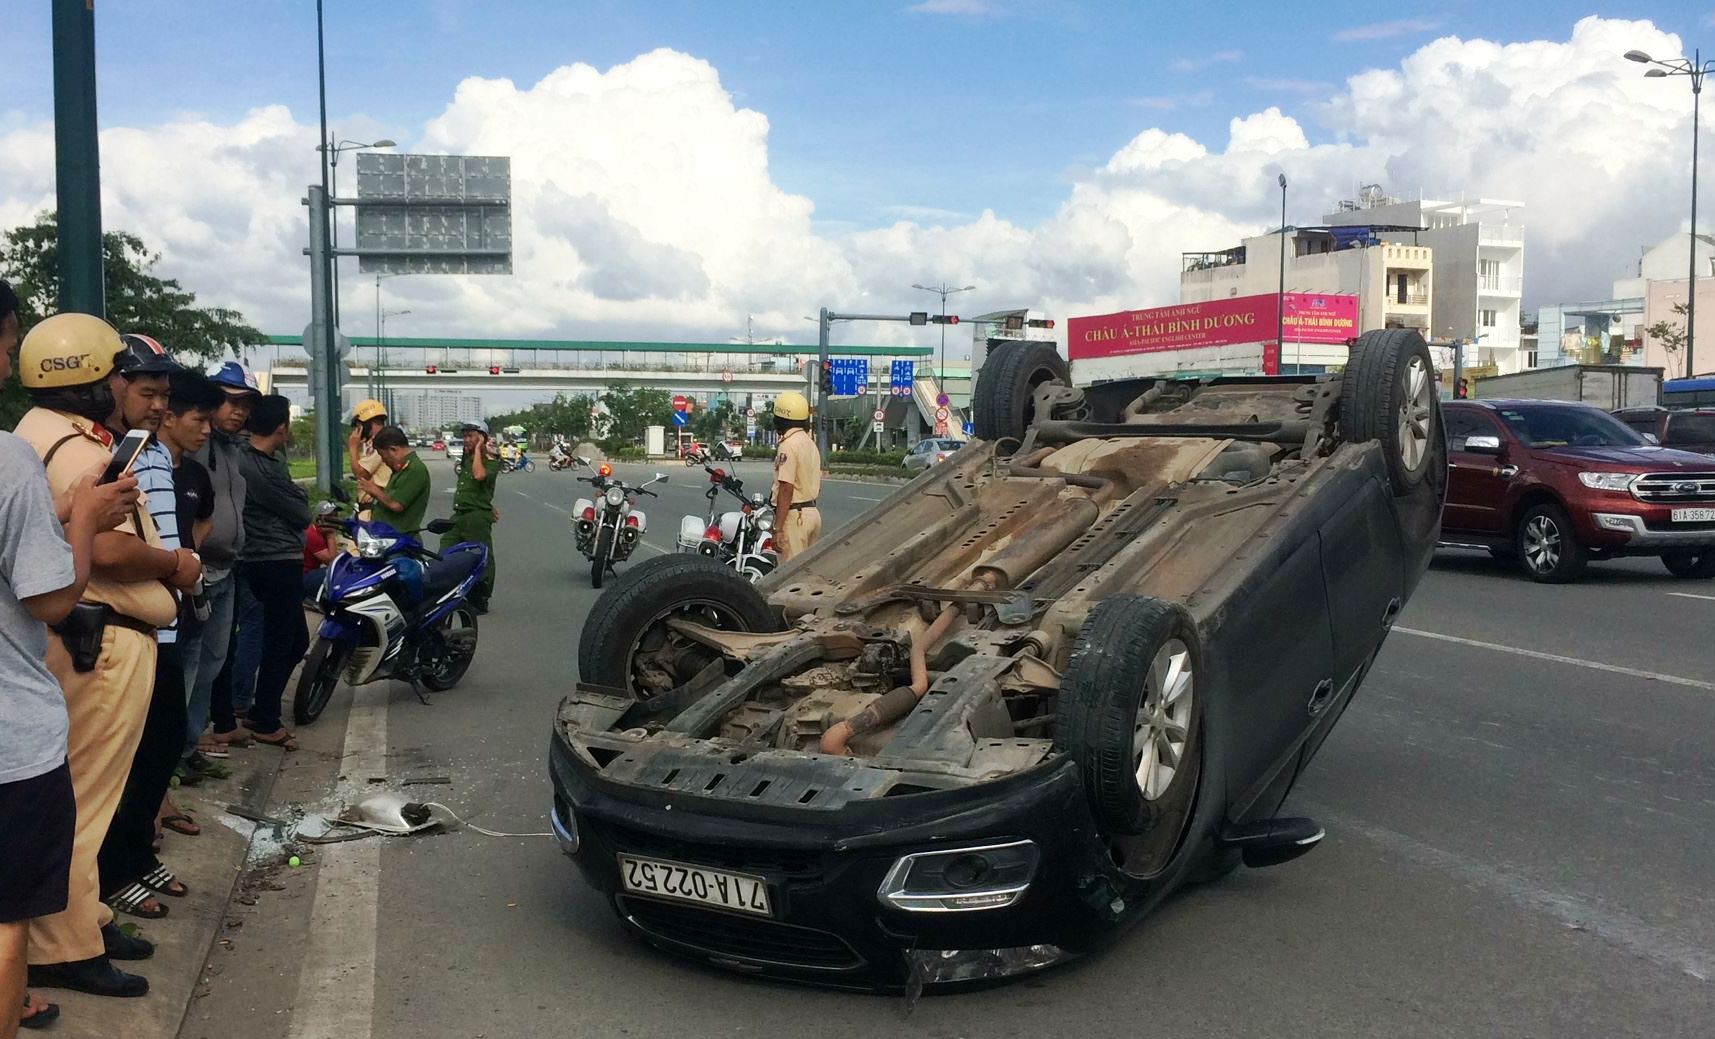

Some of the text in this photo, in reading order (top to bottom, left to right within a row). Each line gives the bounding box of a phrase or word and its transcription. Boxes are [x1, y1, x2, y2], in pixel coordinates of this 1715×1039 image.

[1132, 312, 1154, 321] TRUNG
[1282, 315, 1298, 326] CHÂU
[1085, 312, 1255, 342] CHÂU Á-THÁI BÌNH DƯƠNG
[624, 859, 766, 911] 71A-022.52
